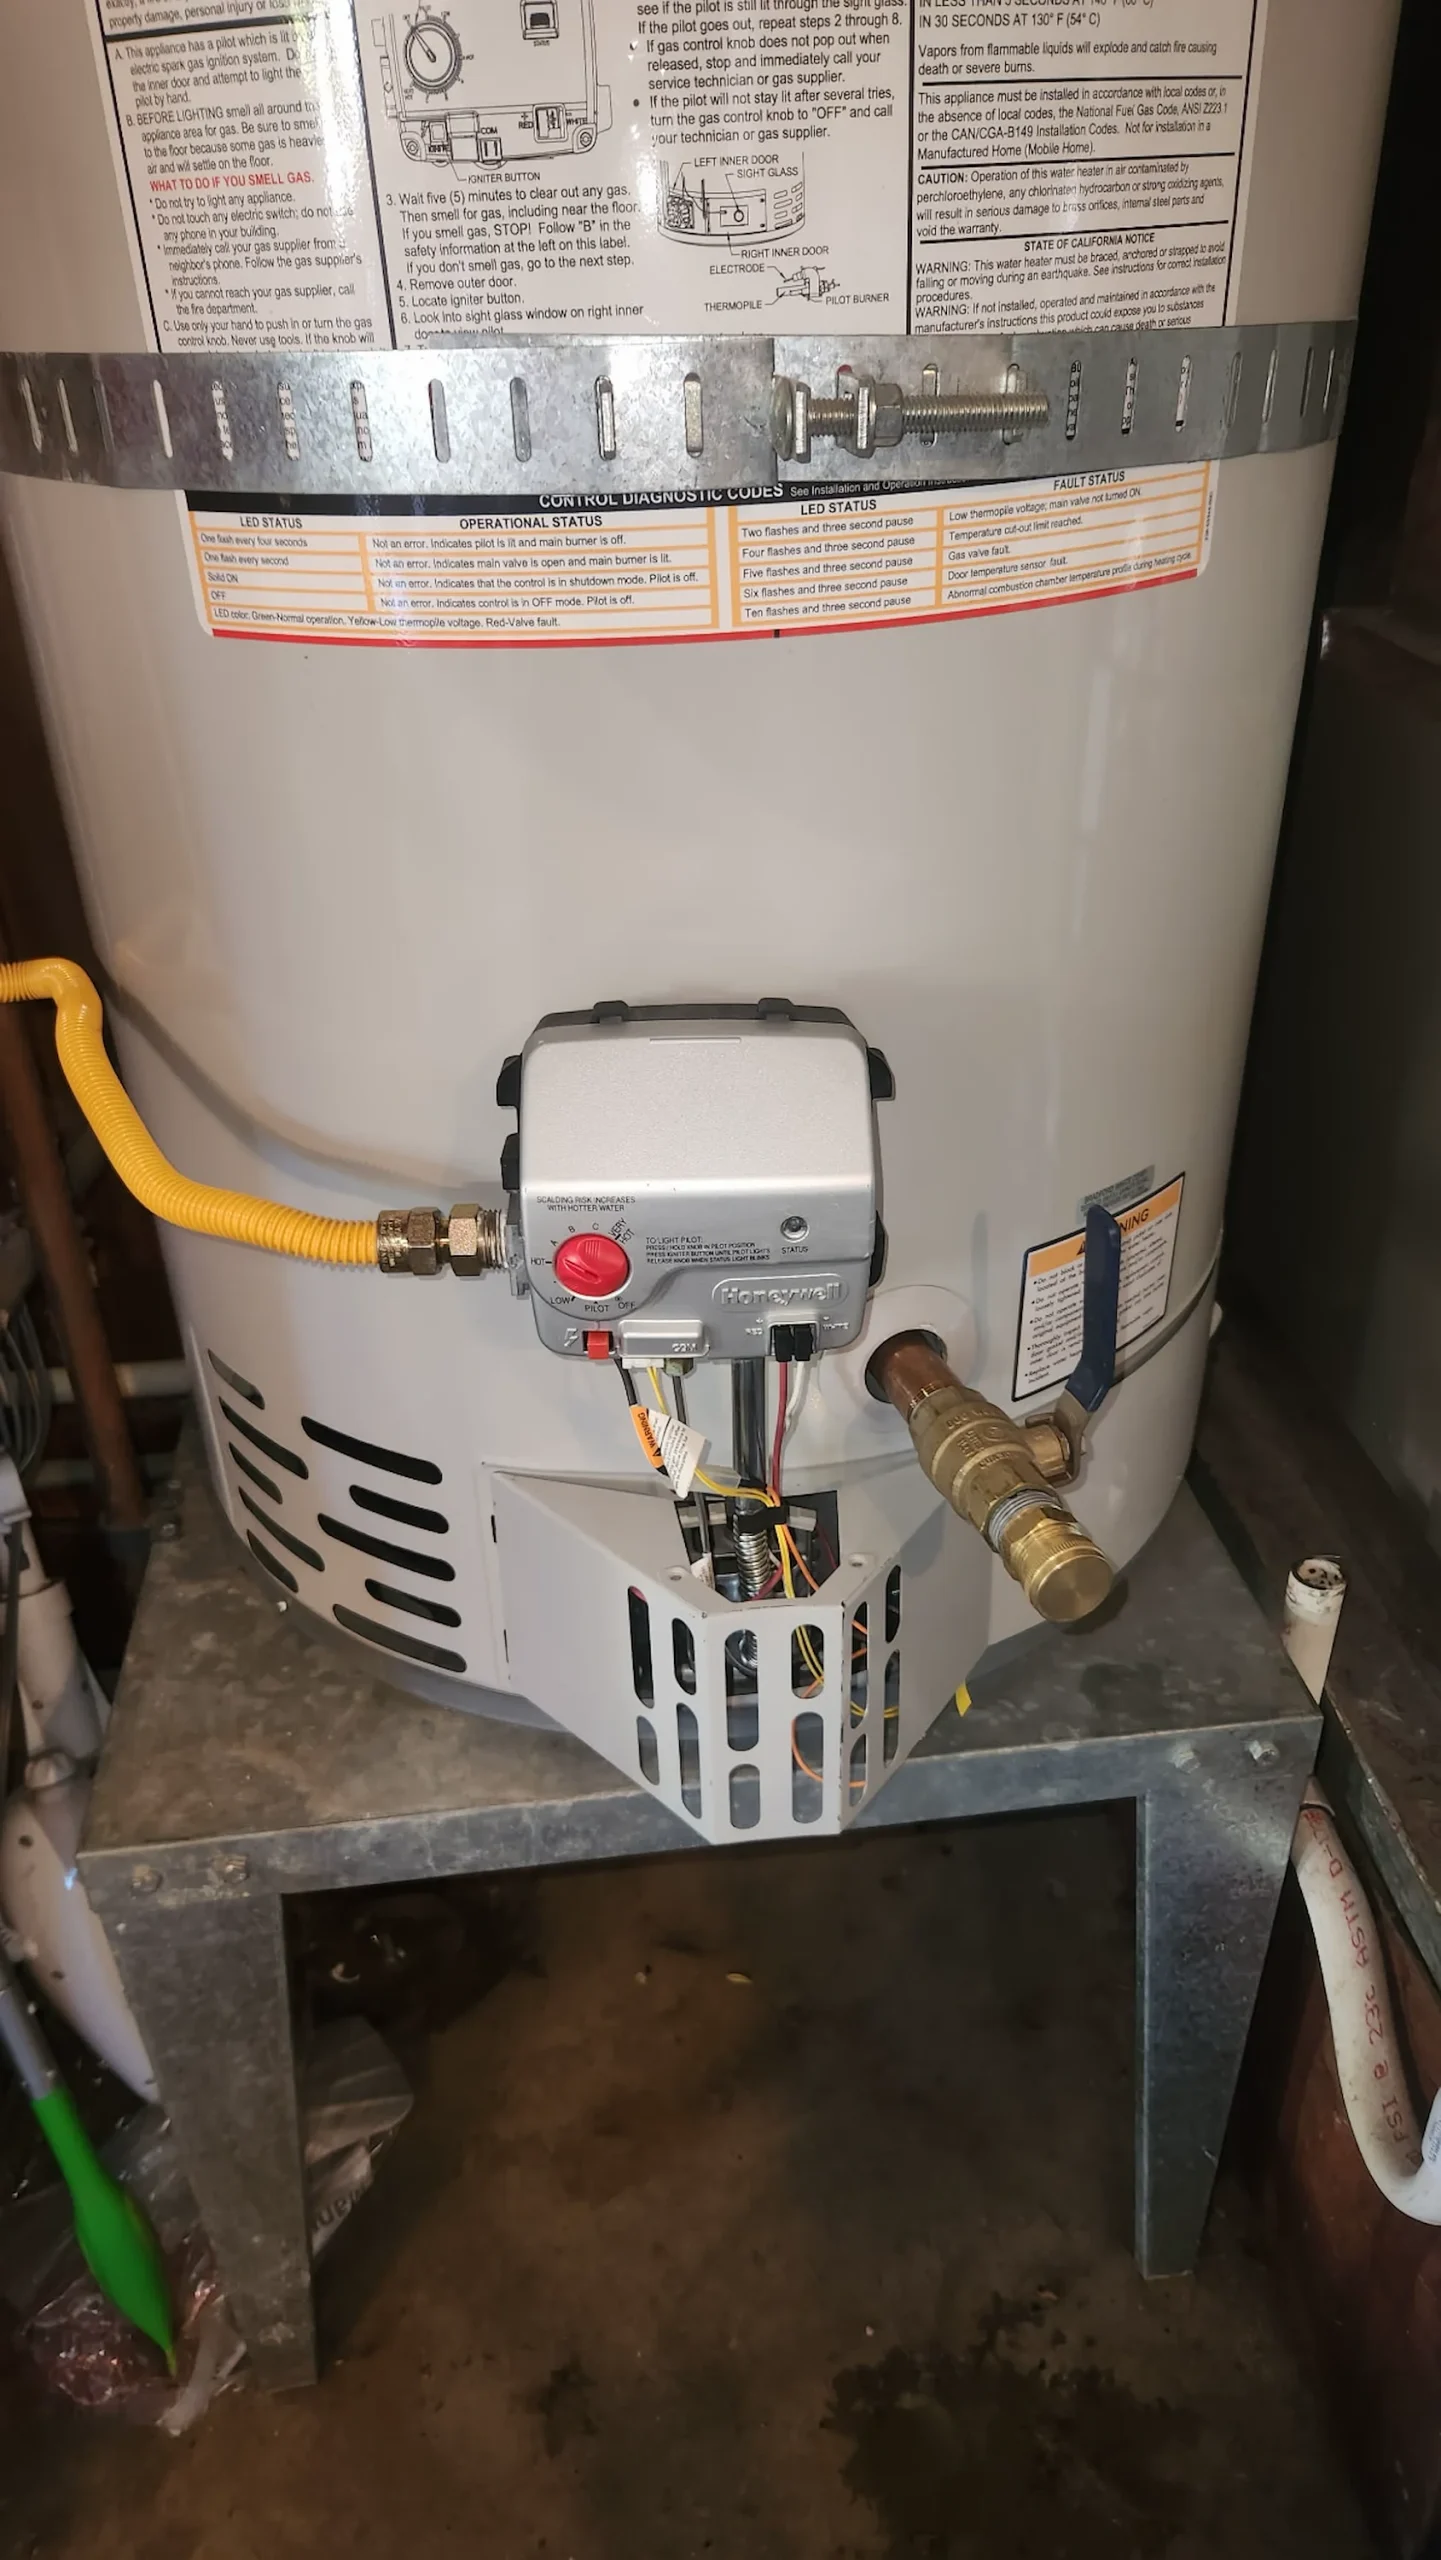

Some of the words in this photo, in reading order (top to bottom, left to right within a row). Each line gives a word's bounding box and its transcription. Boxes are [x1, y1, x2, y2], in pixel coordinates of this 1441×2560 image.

[919, 15, 931, 28] IN
[934, 14, 948, 28] 30
[951, 13, 1011, 28] SECONDS
[1012, 13, 1028, 26] AT
[1056, 12, 1064, 26] F
[1088, 12, 1101, 28] C)
[918, 62, 949, 76] death
[952, 64, 963, 75] or
[965, 63, 1001, 74] severe
[1004, 60, 1035, 73] burns.
[648, 76, 691, 90] service
[694, 73, 754, 88] technician
[756, 75, 770, 86] or
[772, 74, 794, 88] gas
[797, 70, 845, 86] supplier.
[566, 118, 587, 126] WHITE
[650, 114, 674, 126] turn
[677, 112, 696, 126] the
[698, 113, 721, 128] gas
[723, 108, 763, 123] control
[766, 107, 795, 122] knob
[797, 108, 809, 120] to
[811, 105, 847, 119] "OFF"
[849, 104, 871, 118] and
[873, 104, 893, 117] call
[518, 121, 534, 129] RED
[917, 145, 989, 160] Manufactured
[991, 144, 1022, 157] Home
[1024, 142, 1060, 159] (Mobile
[1062, 141, 1095, 156] Home).
[694, 156, 717, 168] LEFT
[719, 155, 749, 166] INNER
[751, 154, 779, 165] DOOR
[468, 173, 503, 184] IGNITER
[504, 171, 541, 183] BUTTON
[737, 167, 766, 179] SIGHT
[767, 166, 799, 177] GLASS
[149, 179, 177, 192] WHAT
[179, 177, 194, 191] TO
[194, 176, 210, 190] DO
[211, 176, 221, 188] IF
[222, 174, 246, 187] YOU
[248, 173, 285, 186] SMELL
[287, 170, 315, 184] GAS.
[386, 193, 396, 206] 3.
[398, 192, 424, 206] Wait
[426, 192, 447, 204] five
[449, 190, 466, 206] (5)
[468, 189, 513, 203] minutes
[515, 188, 527, 201] to
[529, 186, 558, 200] clear
[560, 185, 580, 198] out
[582, 186, 604, 200] any
[606, 186, 630, 200] gas.
[1023, 239, 1055, 252] STATE
[1056, 238, 1069, 249] OF
[1071, 235, 1123, 248] CALIFORNIA
[1125, 232, 1155, 244] NOTICE
[741, 248, 771, 259] RIGHT
[771, 246, 800, 258] INNER
[801, 245, 829, 256] DOOR
[709, 262, 766, 275] ELECTRODE
[396, 279, 407, 291] 4.
[409, 278, 455, 291] Remove
[457, 276, 486, 289] outer
[488, 275, 516, 288] door.
[398, 295, 409, 308] 5.
[411, 295, 448, 307] Locate
[450, 293, 484, 309] igniter
[486, 292, 525, 305] button.
[704, 300, 762, 312] THERMOPILE
[825, 294, 852, 305] PILOT
[852, 292, 890, 304] BURNER
[163, 319, 173, 332] C.
[173, 319, 191, 332] Use
[191, 320, 208, 334] only
[210, 321, 229, 334] your
[230, 318, 254, 331] hand
[254, 318, 264, 331] to
[265, 318, 289, 333] push
[290, 317, 301, 330] in
[301, 319, 313, 330] or
[313, 317, 334, 329] turn
[335, 316, 352, 329] the
[353, 318, 372, 331] gas
[1053, 475, 1086, 491] FAULT
[1088, 470, 1125, 486] STATUS
[540, 493, 618, 508] CONTROL
[623, 490, 722, 505] DIAGNOSTIC
[728, 484, 783, 500] CODES
[801, 503, 825, 516] LED
[828, 499, 877, 514] STATUS
[240, 516, 260, 528] LED
[262, 517, 303, 529] STATUS
[459, 517, 549, 530] OPERATIONAL
[552, 515, 603, 528] STATUS
[741, 527, 763, 538] Two
[764, 525, 799, 537] flashes
[802, 523, 820, 534] and
[822, 522, 847, 533] three
[849, 517, 883, 531] second
[885, 517, 914, 530] pause
[202, 551, 220, 565] One
[220, 552, 237, 563] flash
[238, 556, 259, 567] every
[260, 556, 289, 566] second
[948, 550, 966, 561] Gas
[968, 549, 990, 559] valve
[991, 544, 1011, 556] fault.
[207, 571, 226, 583] Solid
[226, 573, 239, 583] ON
[537, 1196, 572, 1204] SCALDING
[575, 1196, 593, 1204] RISK
[608, 1217, 627, 1237] VERY
[1120, 1208, 1150, 1233] NING
[619, 1228, 635, 1244] HOT
[680, 1236, 702, 1244] PILOT:
[782, 1246, 808, 1254] STATUS
[551, 1297, 570, 1305] LOW
[721, 1282, 842, 1306] Honeywell
[585, 1305, 609, 1313] PILOT
[637, 1412, 656, 1449] WARNING
[1339, 1889, 1370, 1969] ASTM
